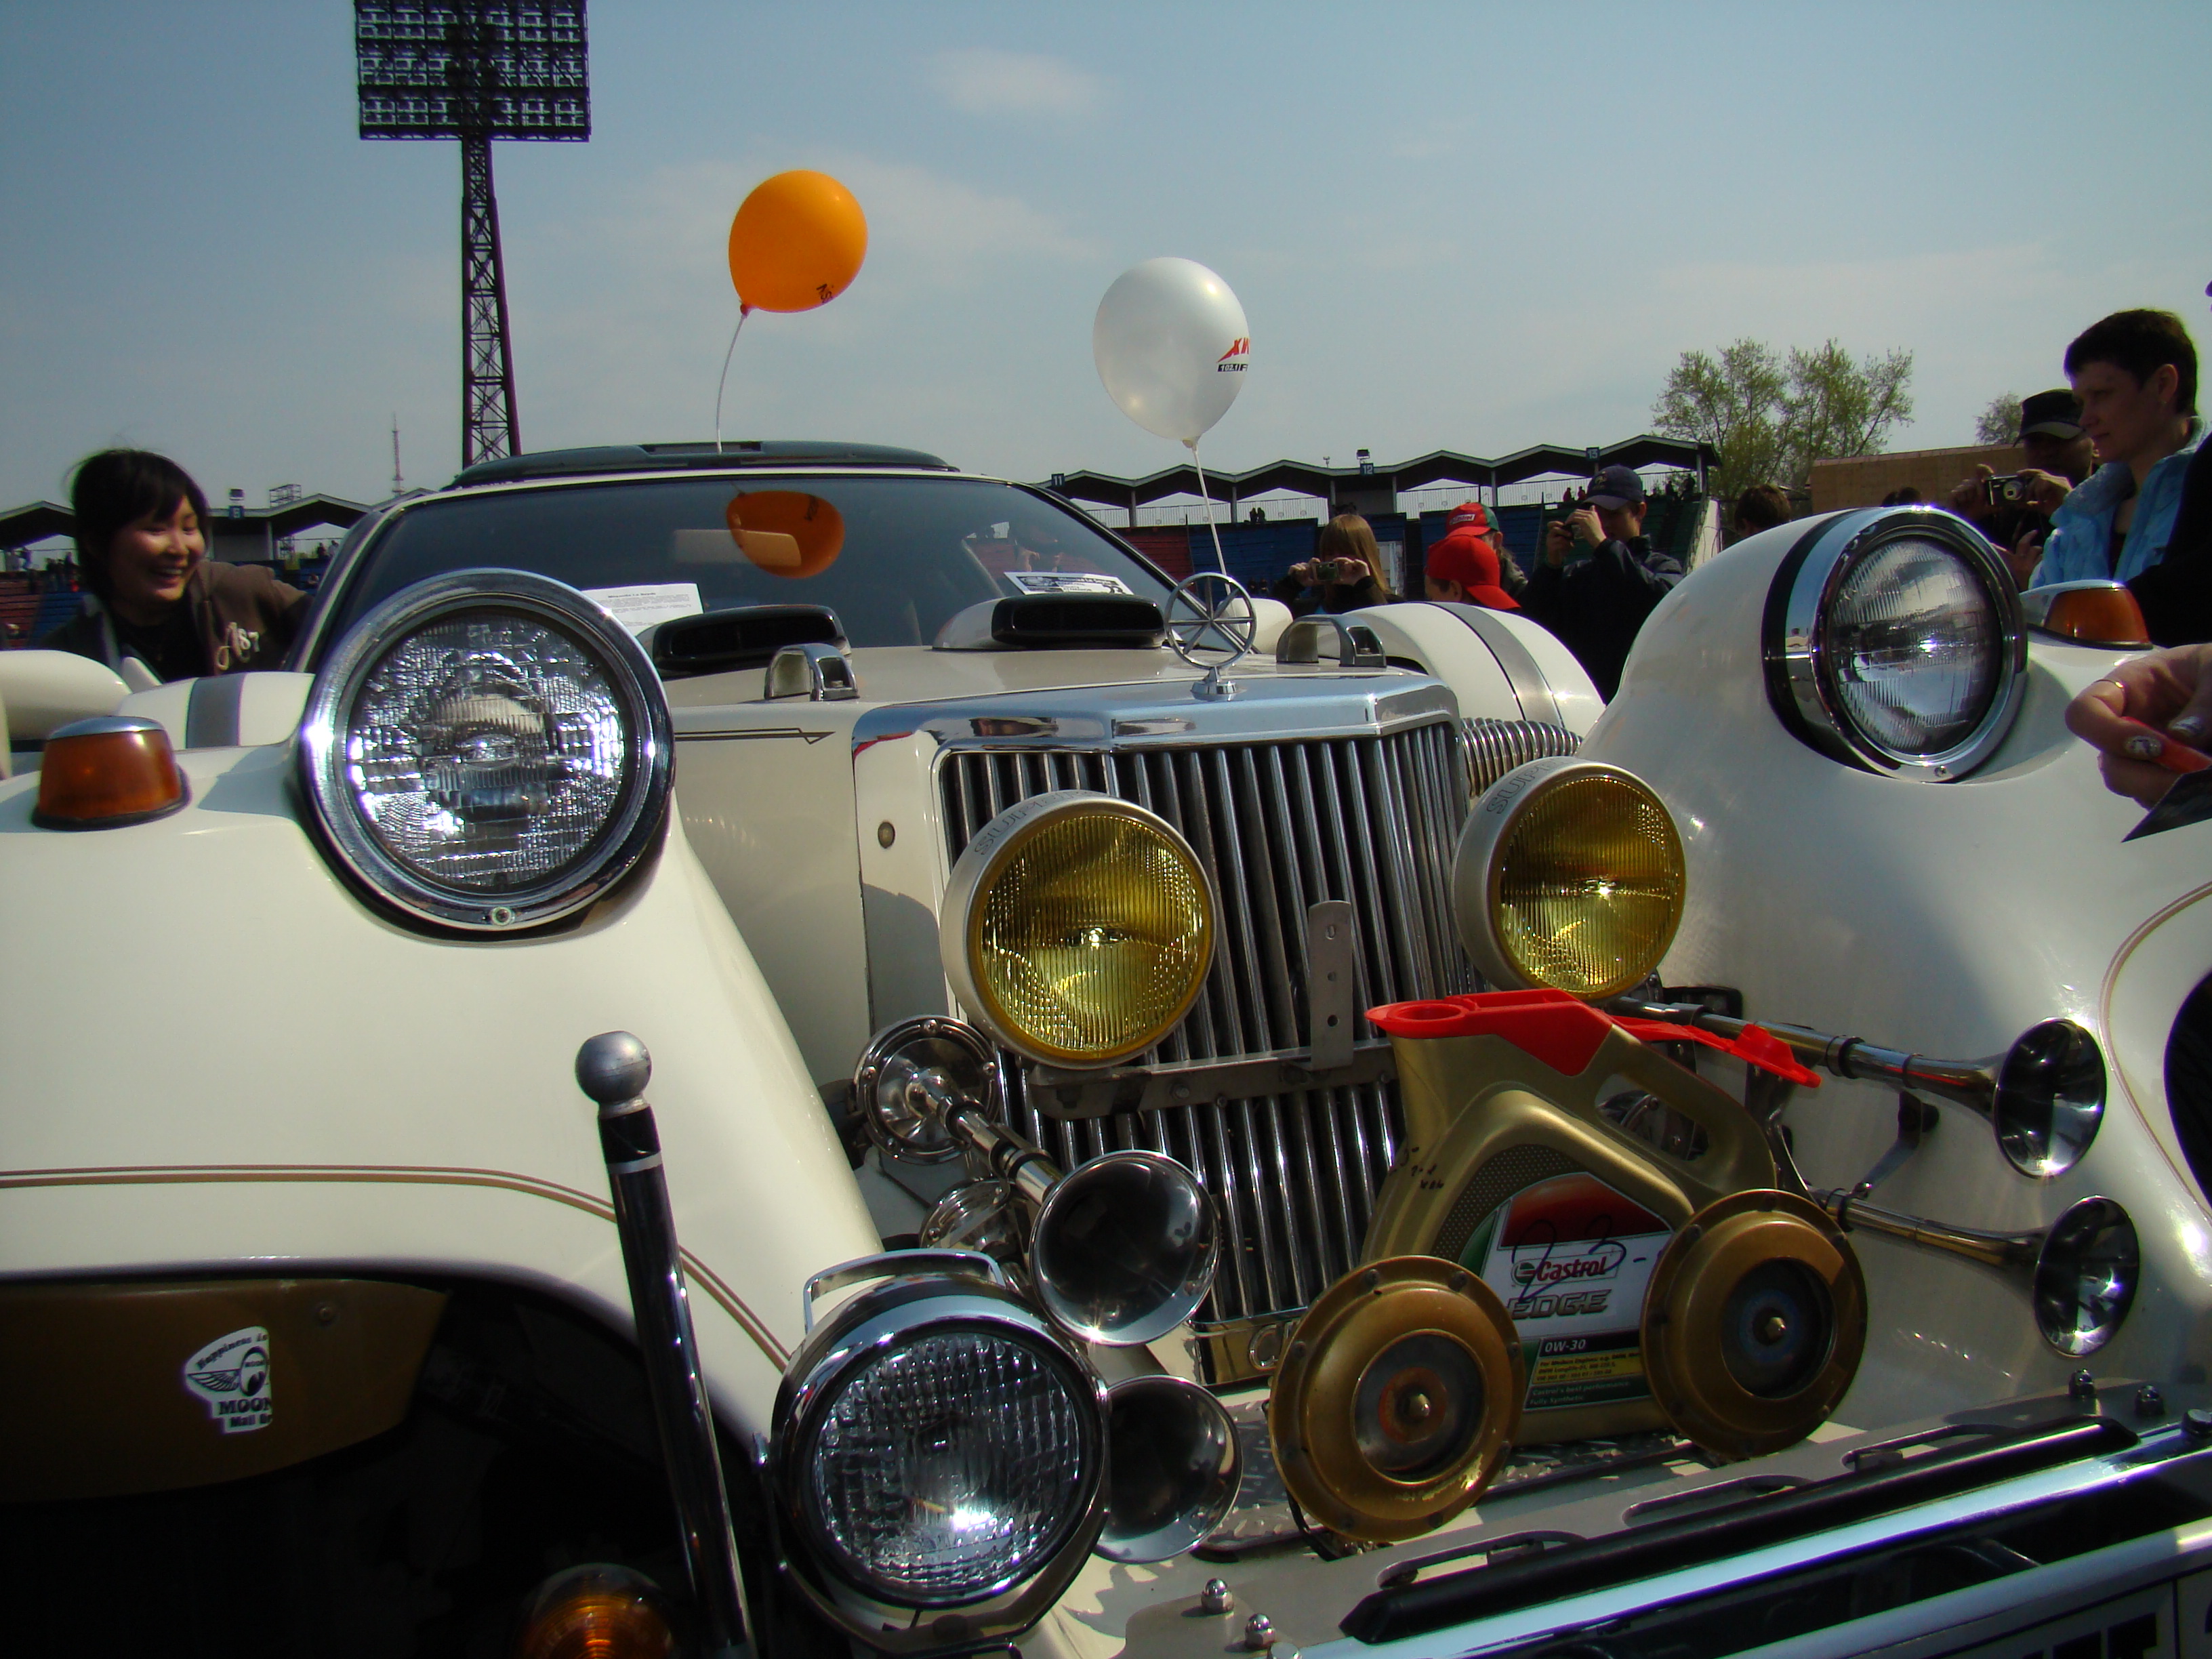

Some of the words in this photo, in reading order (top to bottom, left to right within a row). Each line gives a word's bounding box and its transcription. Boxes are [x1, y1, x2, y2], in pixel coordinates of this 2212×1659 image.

[1587, 449, 1598, 459] 13
[1363, 464, 1373, 474] 12
[1053, 476, 1062, 485] 11
[1536, 1256, 1607, 1282] Castrol
[1508, 1289, 1612, 1319] EDGE
[1544, 1339, 1586, 1353] 0W-30
